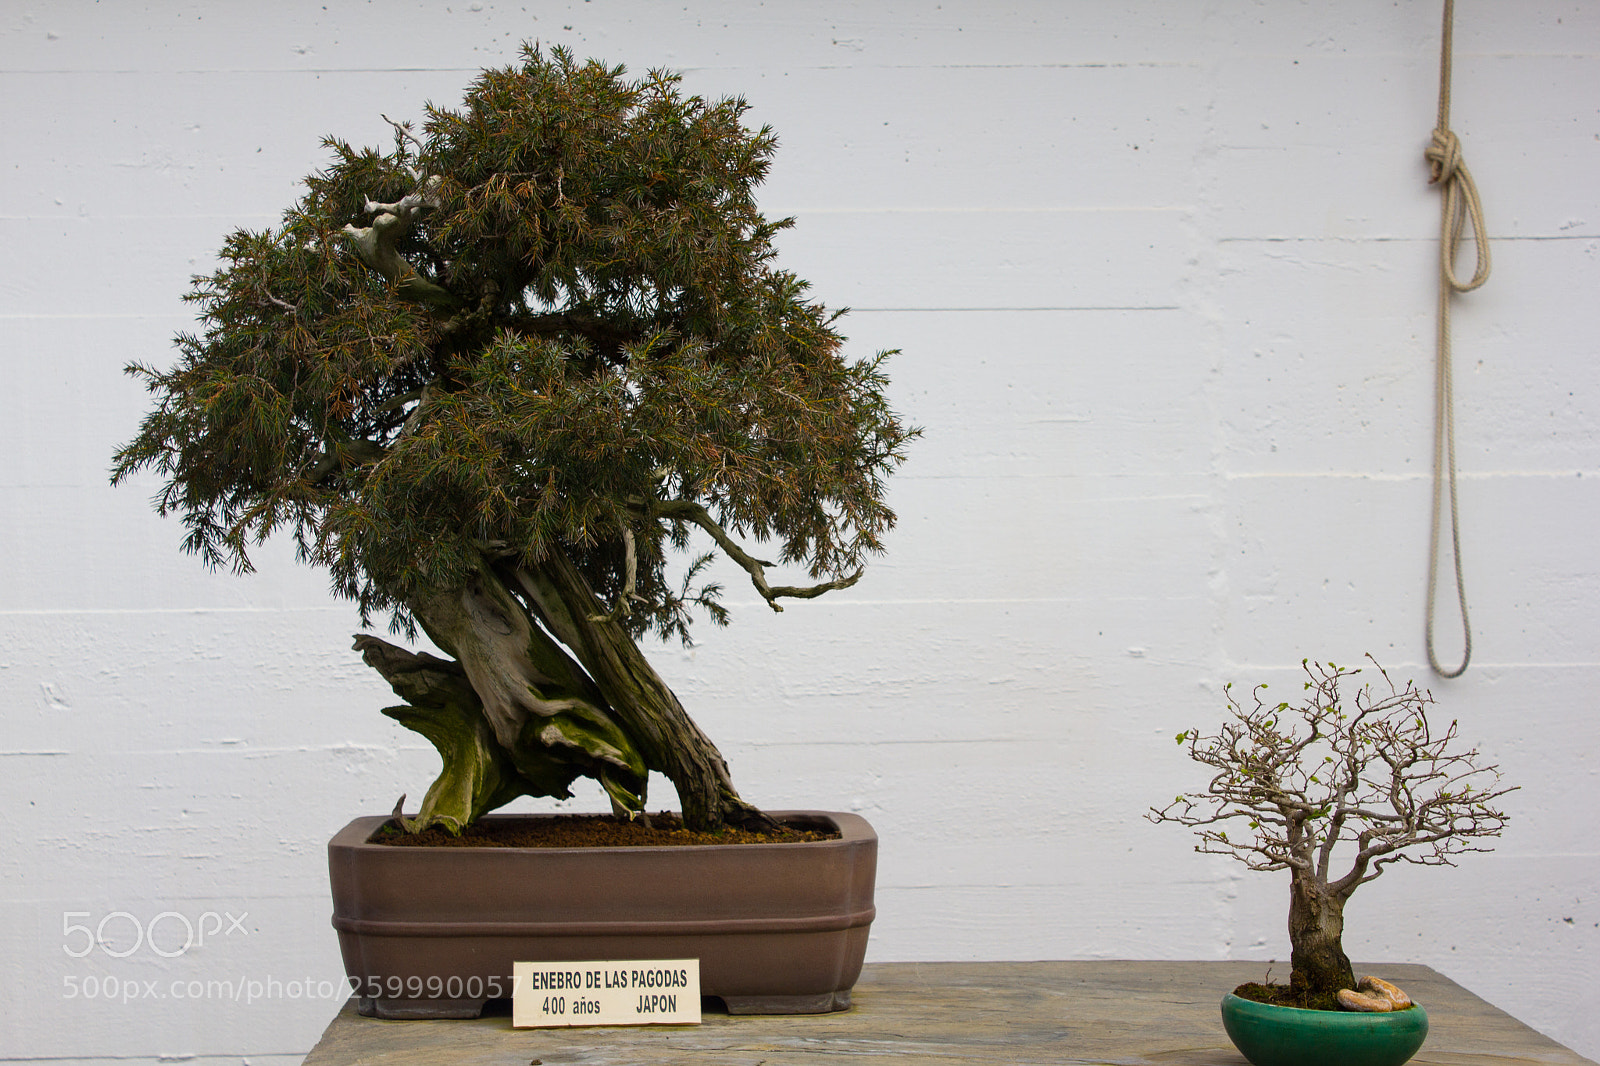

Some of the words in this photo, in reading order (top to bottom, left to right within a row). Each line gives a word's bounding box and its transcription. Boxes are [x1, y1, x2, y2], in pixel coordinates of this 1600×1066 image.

[532, 971, 582, 990] ENEBRO
[585, 971, 601, 989] DE
[605, 970, 628, 988] LAS
[631, 969, 687, 988] PAGODAS
[542, 996, 566, 1015] 400
[572, 996, 601, 1015] años
[636, 994, 677, 1014] JAPON
